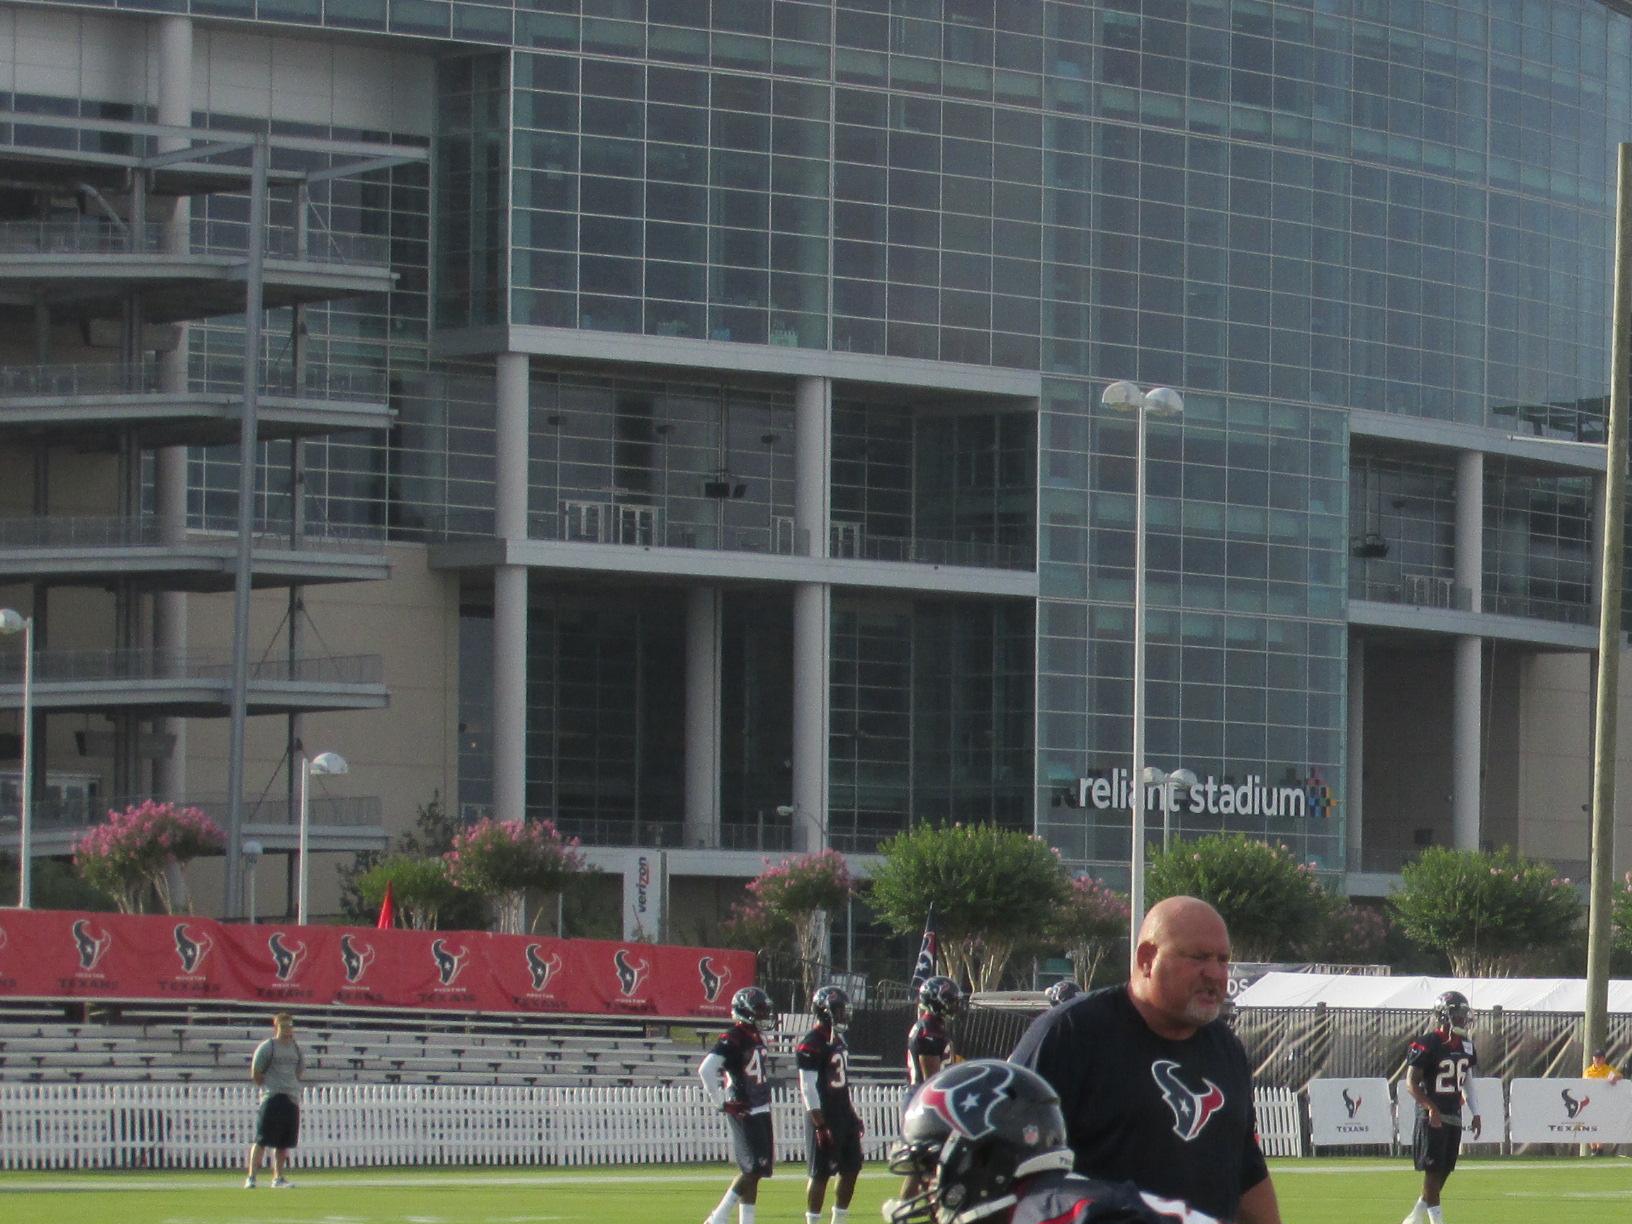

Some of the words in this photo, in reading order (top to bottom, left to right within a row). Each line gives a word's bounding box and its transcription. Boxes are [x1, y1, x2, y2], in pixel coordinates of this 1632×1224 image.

[1190, 775, 1305, 817] stadium
[636, 857, 649, 912] verizon
[1337, 1125, 1369, 1133] TEXANS
